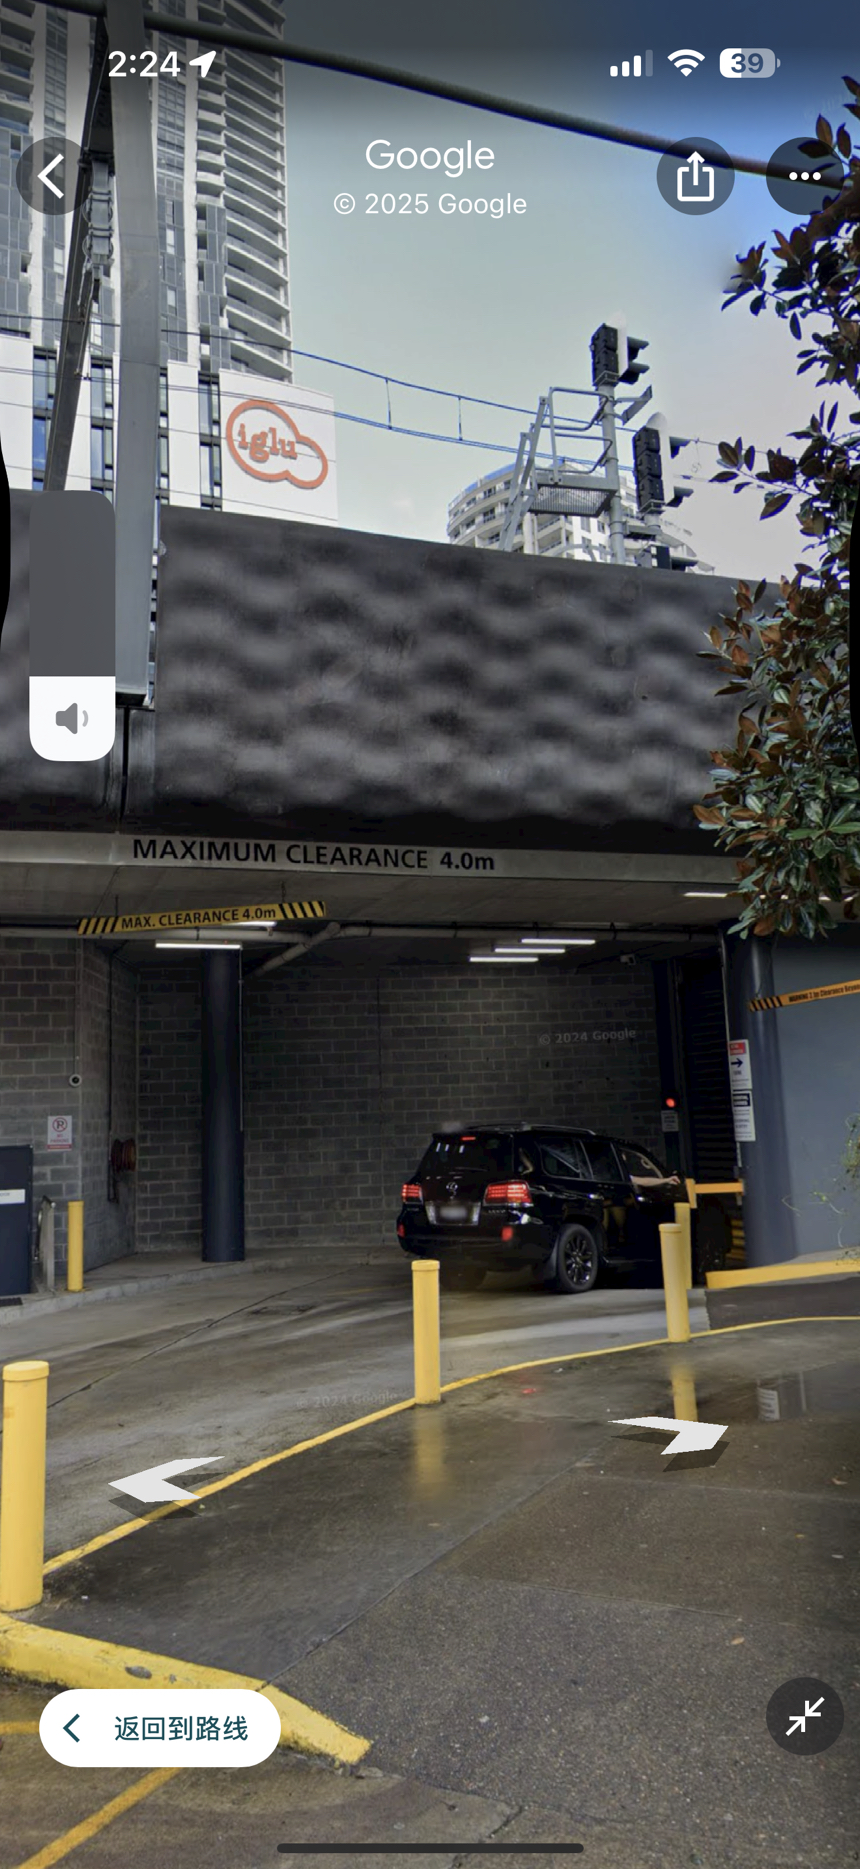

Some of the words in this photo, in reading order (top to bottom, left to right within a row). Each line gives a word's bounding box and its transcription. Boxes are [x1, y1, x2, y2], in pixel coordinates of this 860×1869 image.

[238, 423, 298, 463] iglu
[133, 839, 276, 863] MAXIMUM
[286, 844, 428, 869] CLEARANCE
[440, 852, 495, 871] 4.0m
[121, 916, 156, 929] MAX.
[159, 908, 239, 926] CLEARANCE
[242, 907, 276, 919] 4.0m
